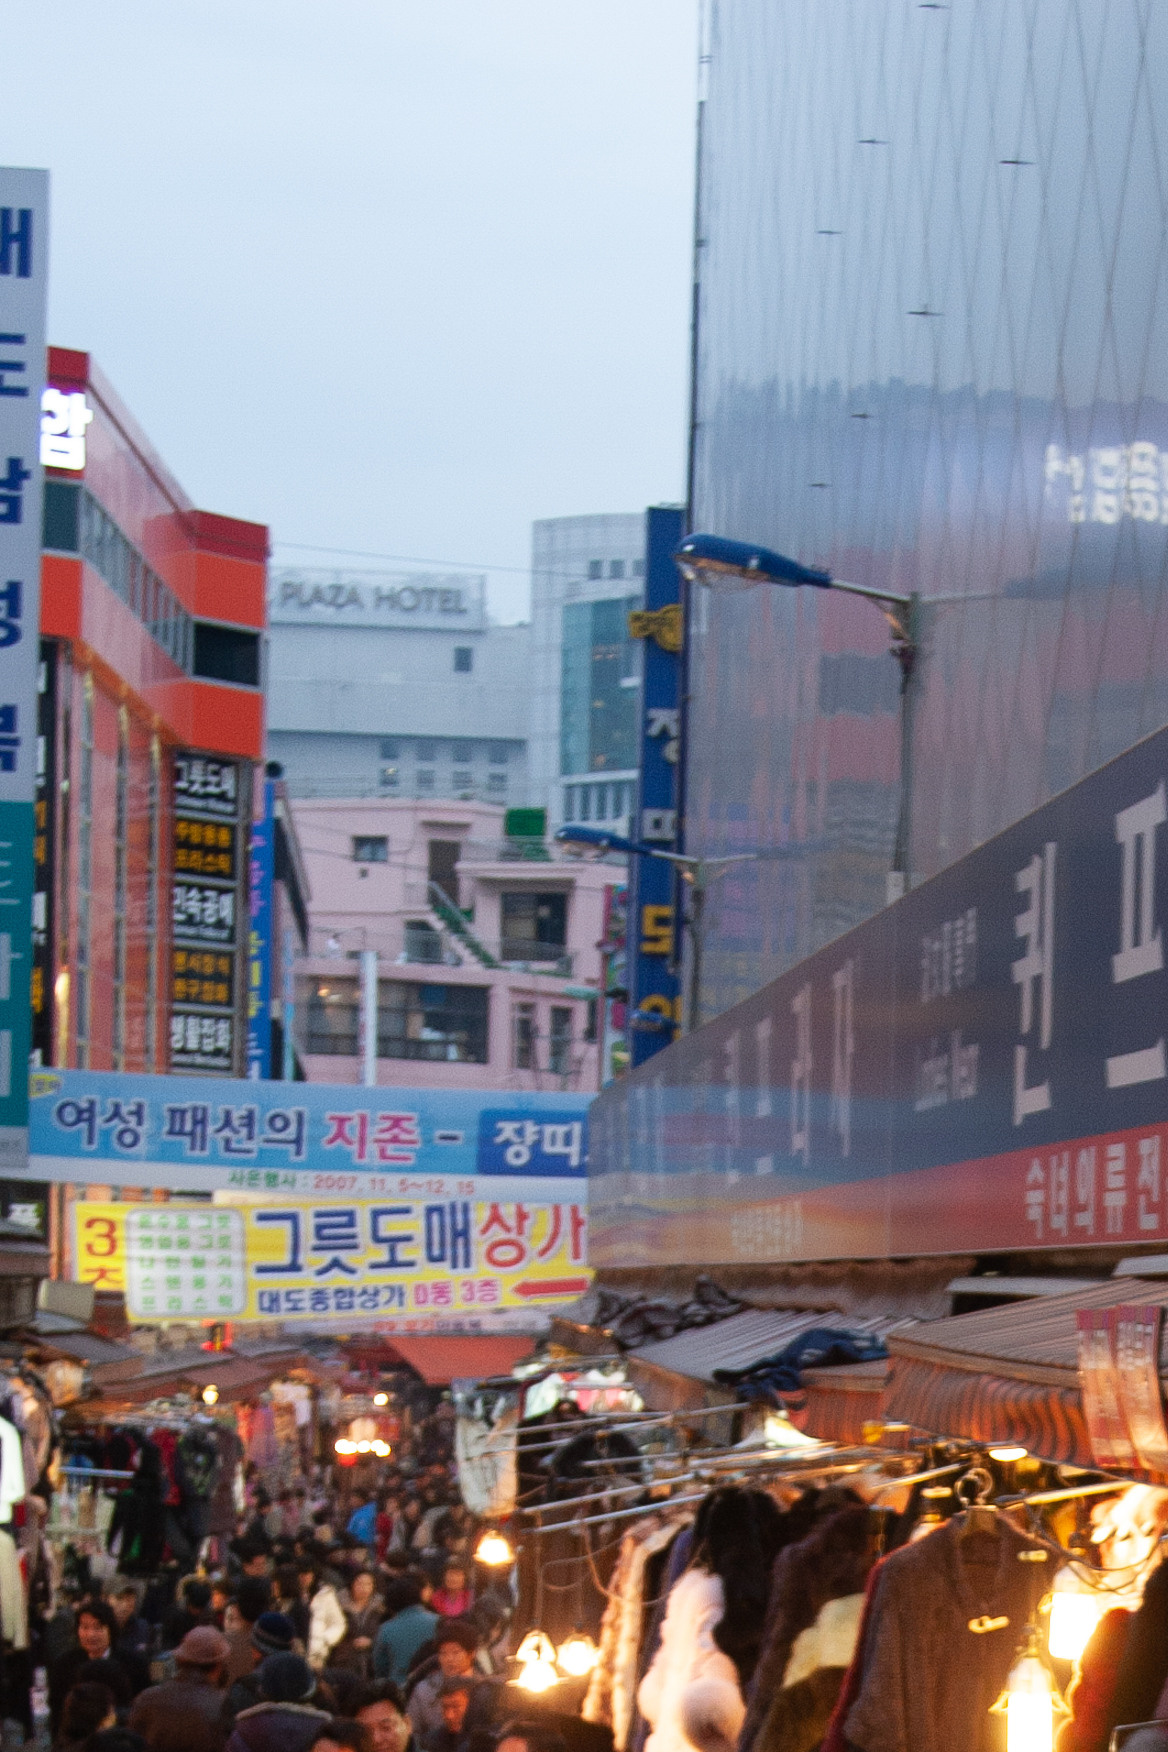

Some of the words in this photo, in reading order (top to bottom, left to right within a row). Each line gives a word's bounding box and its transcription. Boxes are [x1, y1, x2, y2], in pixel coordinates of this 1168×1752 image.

[281, 581, 363, 610] PLAZA
[374, 585, 467, 615] HOTEL
[55, 1098, 145, 1151] 여성
[165, 1105, 306, 1158] 패션의
[324, 1113, 420, 1162] 지존
[258, 1284, 405, 1315] 대도종합상가
